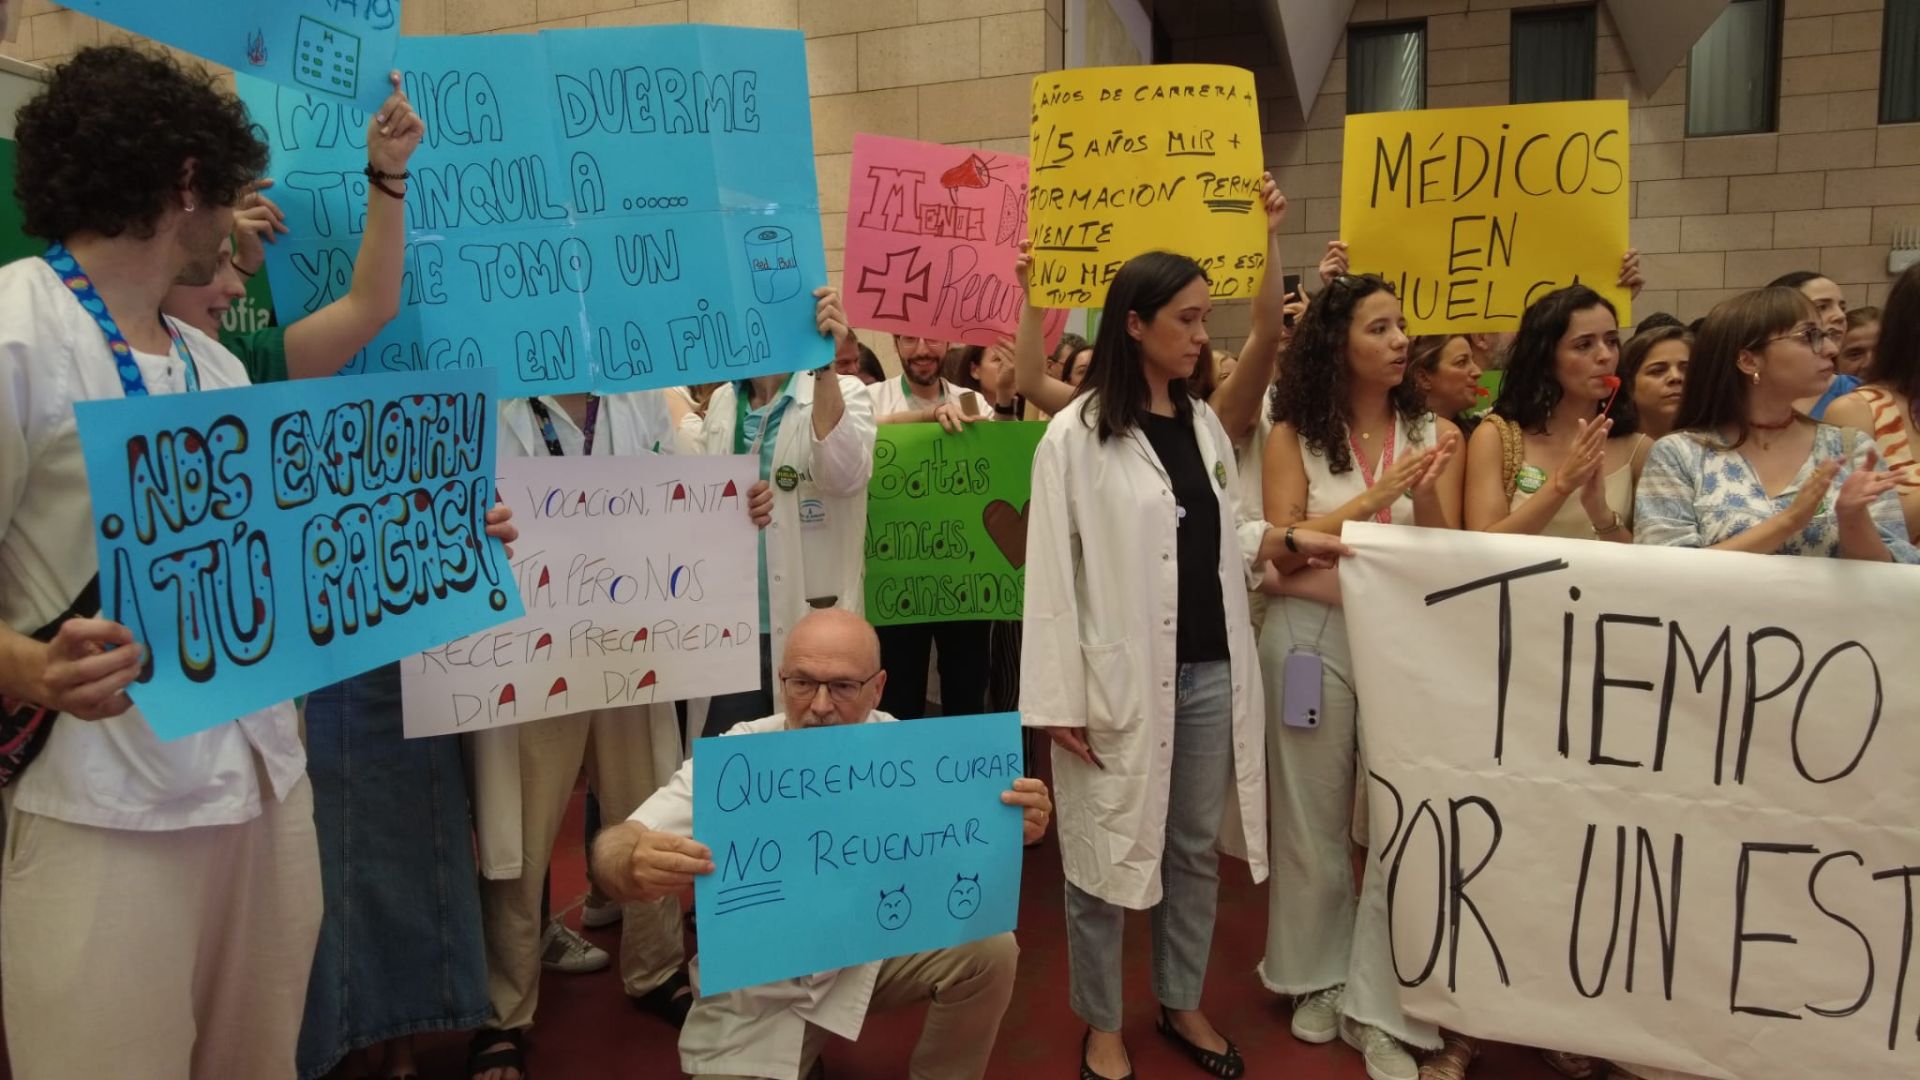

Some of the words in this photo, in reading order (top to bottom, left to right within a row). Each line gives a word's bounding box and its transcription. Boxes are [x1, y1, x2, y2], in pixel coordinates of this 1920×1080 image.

[556, 66, 760, 138] DUERME
[1041, 83, 1084, 107] AÑOS
[1099, 88, 1123, 102] DE
[1134, 83, 1237, 102] CARRERA
[1083, 130, 1149, 159] AÑOS
[459, 237, 593, 303] TOMO
[615, 229, 680, 286] UN
[1447, 211, 1518, 277] EN
[515, 326, 576, 382] EN
[599, 321, 653, 380] LA
[126, 414, 253, 546] NOS
[657, 478, 739, 512] TANTA
[868, 438, 991, 501] Batas
[567, 553, 639, 607] PERO
[645, 552, 705, 603] NOS
[452, 682, 517, 727] DÍA
[544, 676, 569, 712] A
[602, 669, 657, 704] DÍA
[716, 752, 917, 813] QUEREMOS
[935, 752, 1023, 784] CURAR
[721, 837, 783, 883] NO
[1568, 822, 1684, 1001] UN
[1730, 839, 1920, 1051] EST
